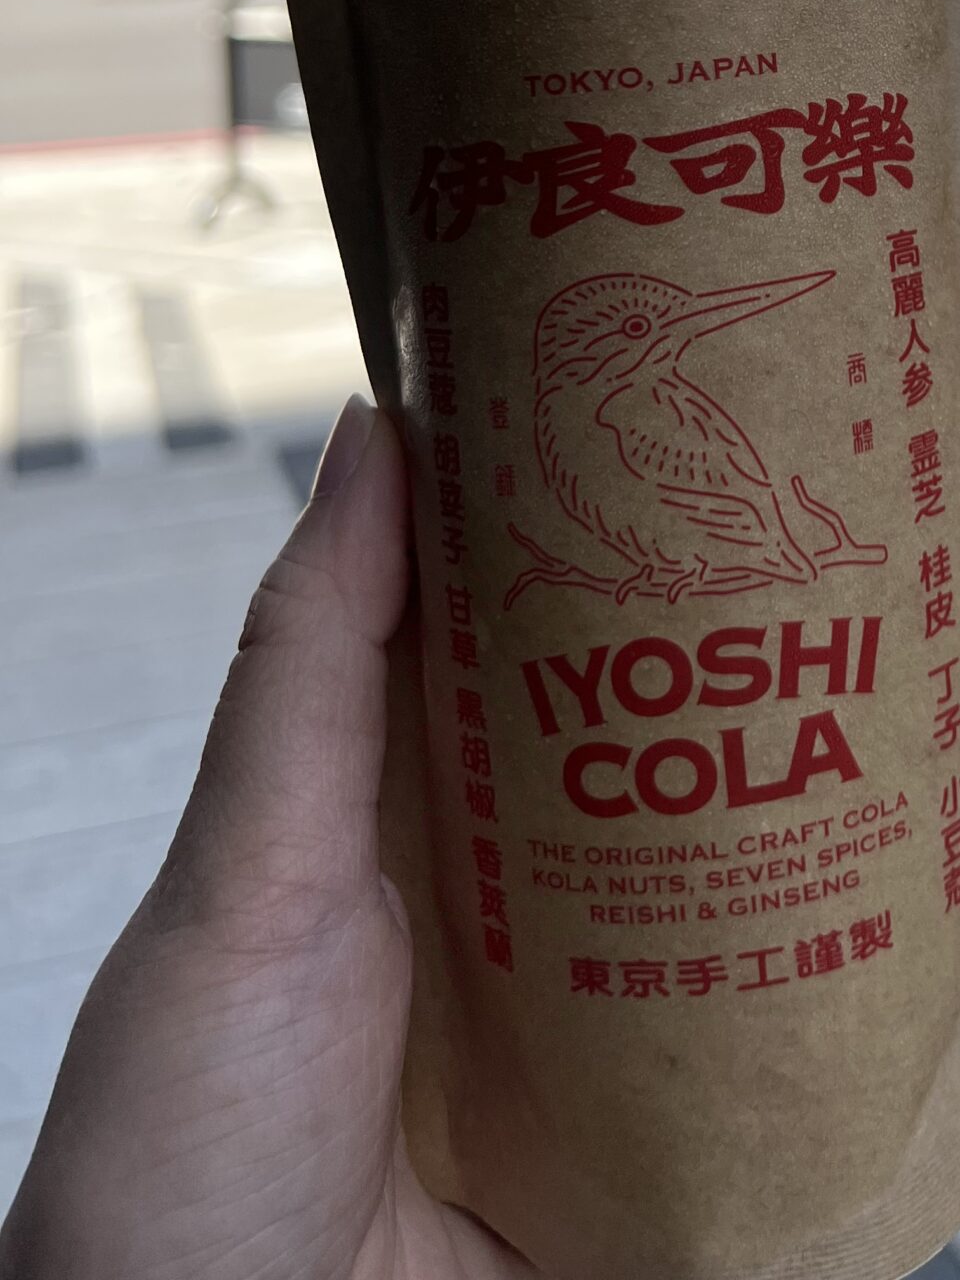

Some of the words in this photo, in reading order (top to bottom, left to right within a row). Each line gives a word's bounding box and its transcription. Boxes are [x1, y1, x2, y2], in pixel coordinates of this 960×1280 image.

[526, 67, 656, 97] TOKYO,
[667, 52, 779, 84] JAPAN
[408, 92, 916, 243] 伊良可樂
[885, 228, 935, 408] 高麗人参
[908, 428, 947, 525] 霊芝
[445, 582, 482, 669] 甘草
[918, 543, 958, 640] 桂皮
[520, 616, 883, 738] IYOSHI
[561, 709, 864, 820] COLA
[527, 838, 576, 866] THE
[584, 839, 729, 867] ORIGINAL
[736, 817, 833, 858] CRAFT
[842, 792, 909, 829] COLA
[531, 867, 599, 895] KOLA
[608, 873, 695, 897] NUTS,
[706, 854, 807, 890] SEVEN
[816, 820, 913, 867] SPICES,
[589, 903, 688, 926] REISHI
[697, 902, 718, 921] &
[727, 868, 861, 917] GINSENG
[567, 909, 894, 1000] 東京手工謹製
